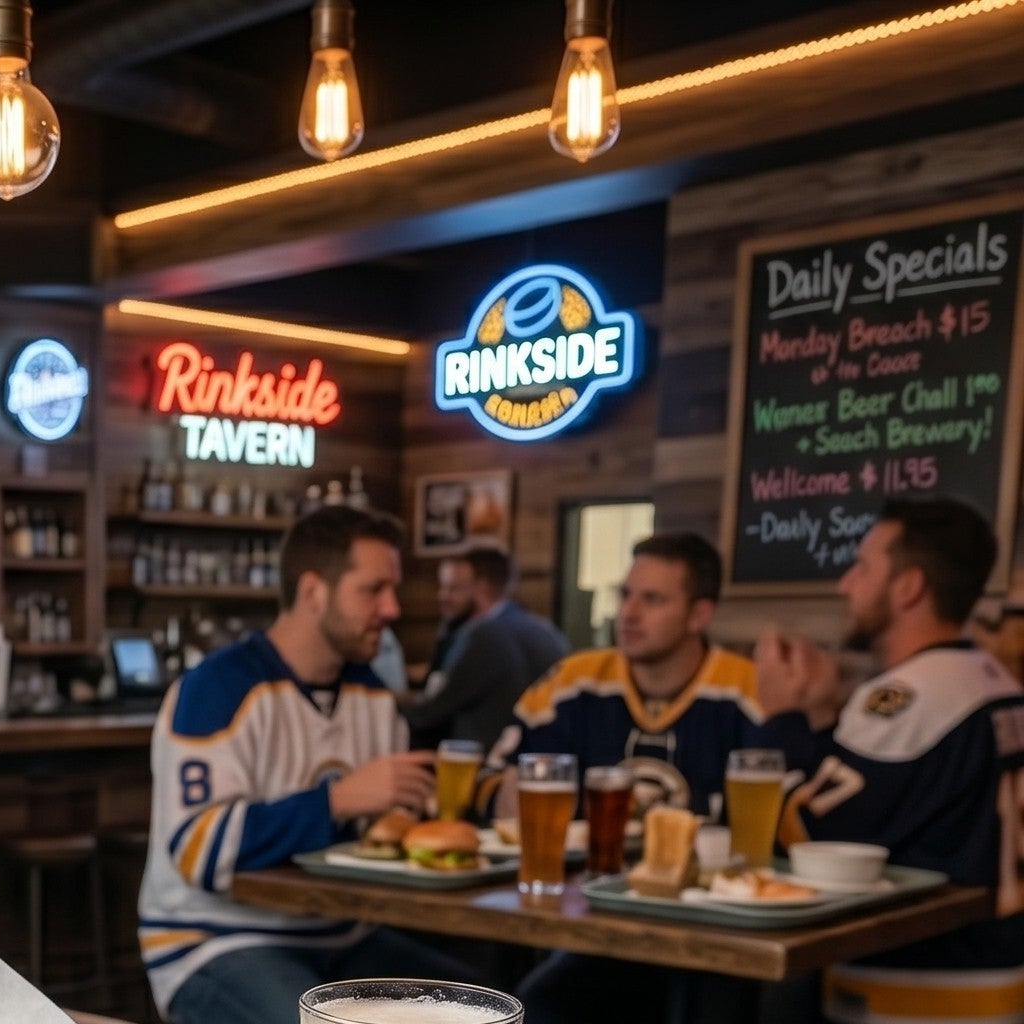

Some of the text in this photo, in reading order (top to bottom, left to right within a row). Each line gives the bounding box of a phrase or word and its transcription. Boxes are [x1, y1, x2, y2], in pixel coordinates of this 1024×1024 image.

[769, 223, 1006, 312] Daily Specials
[158, 342, 340, 425] Rinkside
[445, 326, 622, 396] RINKSIDE
[839, 389, 894, 421] Beer
[179, 415, 316, 469] TAVERN
